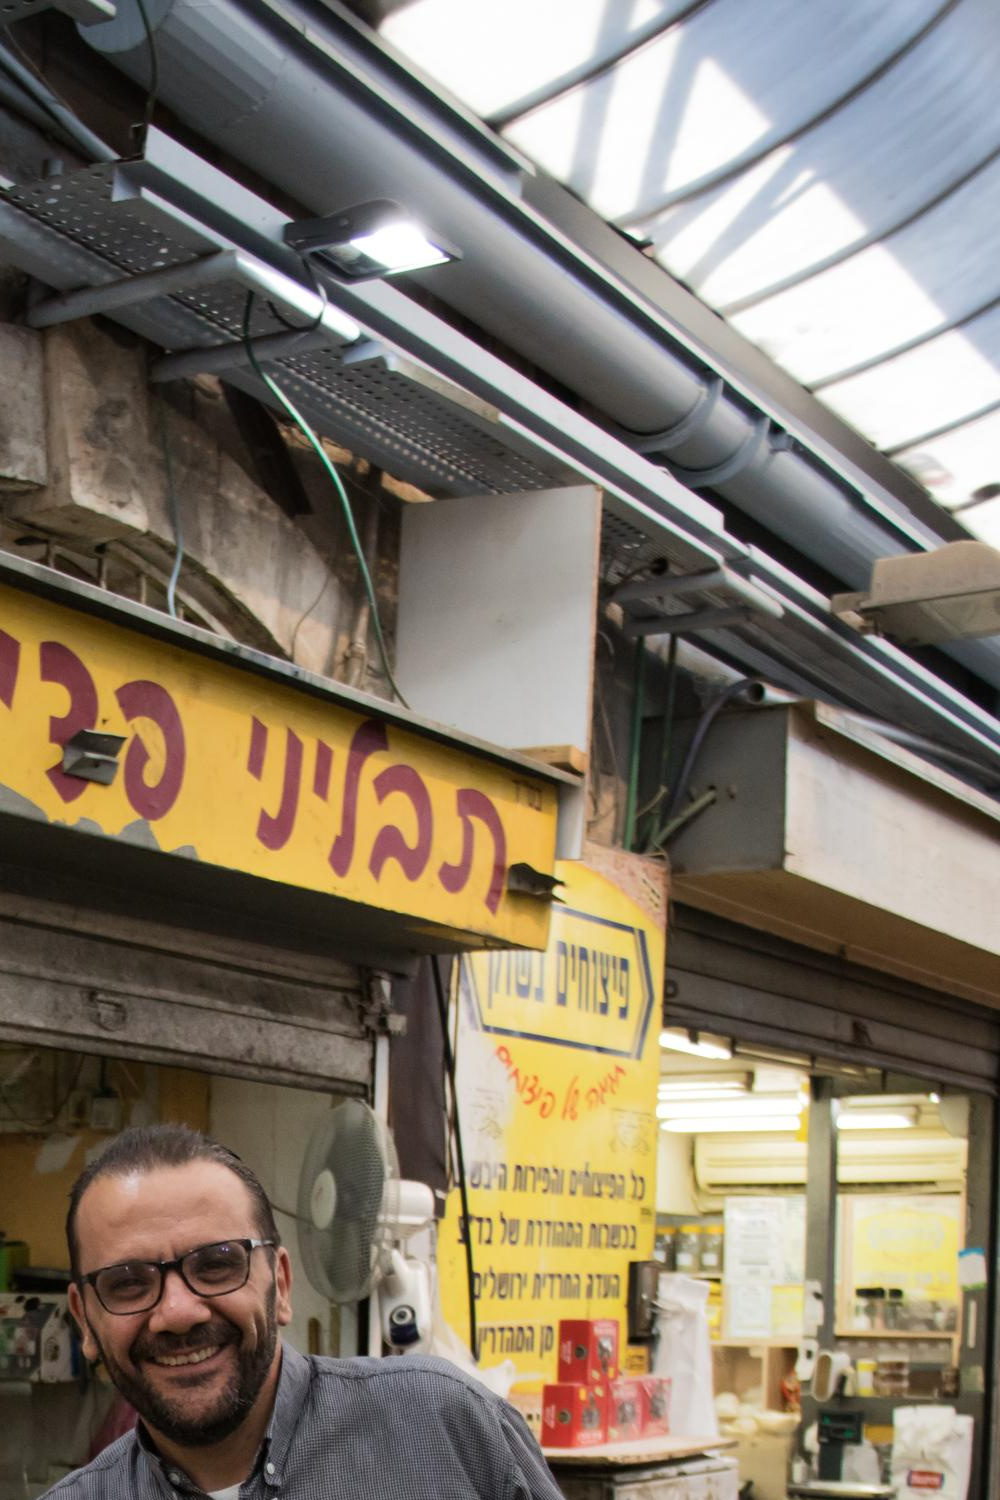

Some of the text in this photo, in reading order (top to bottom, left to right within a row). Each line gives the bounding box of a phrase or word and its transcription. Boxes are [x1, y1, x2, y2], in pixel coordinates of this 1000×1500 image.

[247, 715, 507, 917] תבליני
[556, 940, 629, 1020] פיצוחים
[495, 1045, 556, 1119] פיצוחים
[561, 1074, 580, 1121] של
[513, 1164, 564, 1193] והפירות
[630, 1169, 645, 1201] כל
[499, 1212, 520, 1245] של
[525, 1219, 583, 1248] המהודרת
[589, 1222, 637, 1250] בכשרות
[473, 1266, 527, 1299] ירושלים
[532, 1272, 581, 1300] החרדית
[540, 1325, 554, 1359] מן
